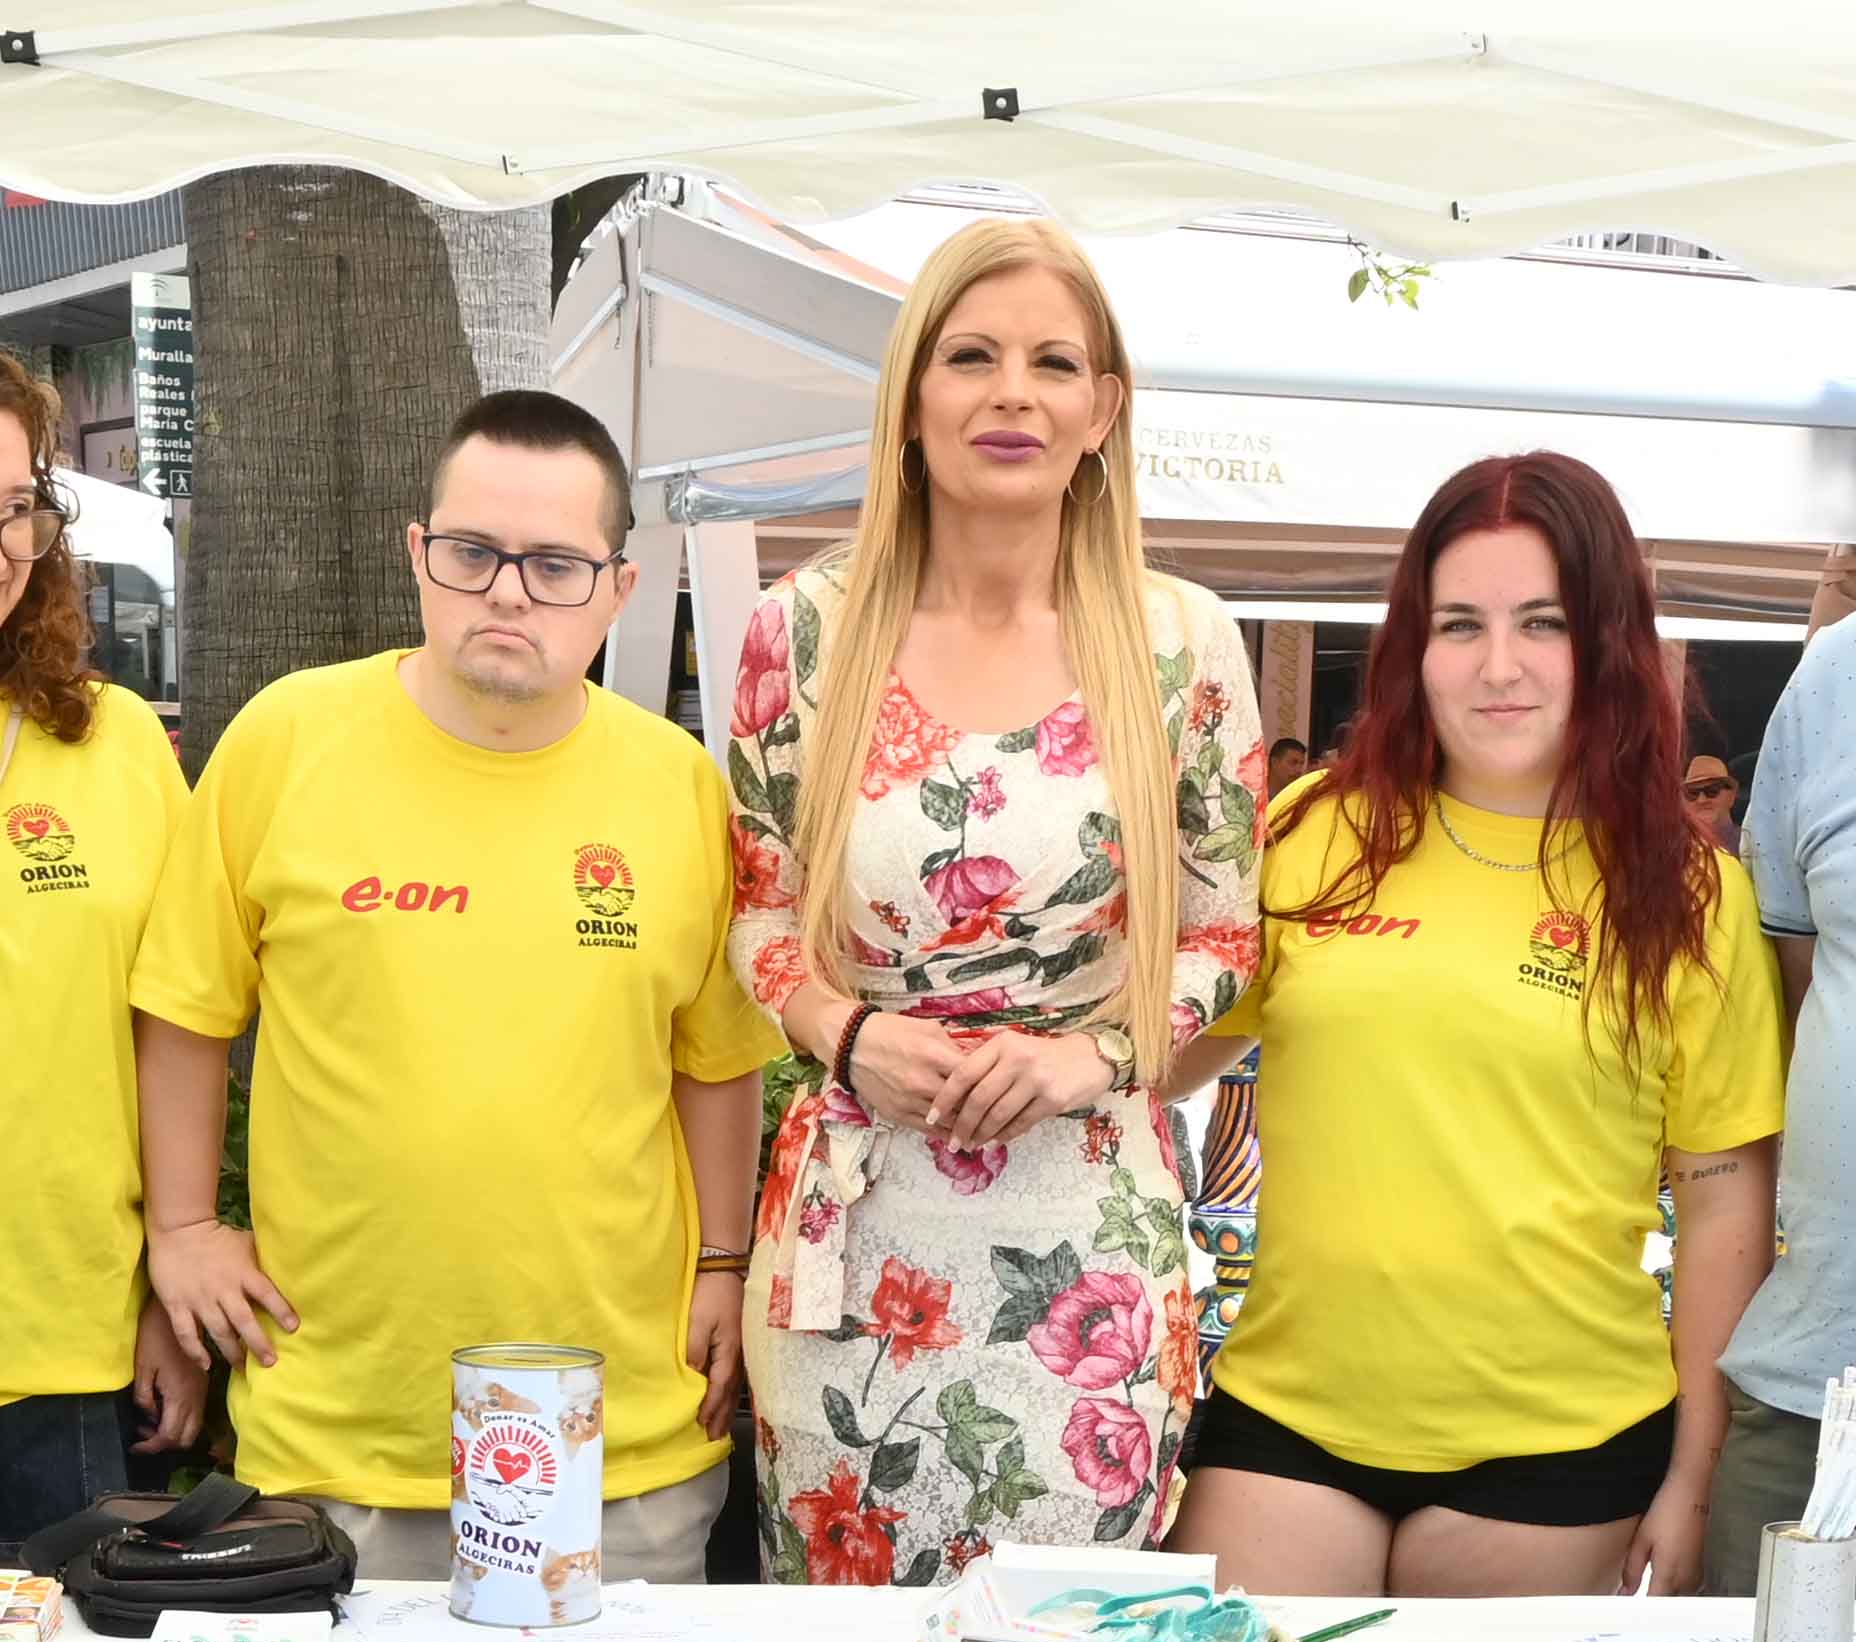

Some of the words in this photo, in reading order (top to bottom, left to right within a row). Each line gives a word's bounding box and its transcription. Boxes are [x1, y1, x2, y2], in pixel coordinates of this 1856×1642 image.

[138, 373, 181, 386] Baños
[138, 386, 185, 401] Reales
[140, 405, 187, 419] parque
[1139, 427, 1273, 454] CERVEZAS
[20, 864, 87, 883] ORION
[26, 880, 90, 894] ALGECIRAS
[575, 919, 638, 938] ORION
[578, 937, 637, 950] ALGECIRAS
[1518, 963, 1584, 993] ORION
[460, 1520, 543, 1560] ORION
[458, 1545, 536, 1576] ALGECIRAS
